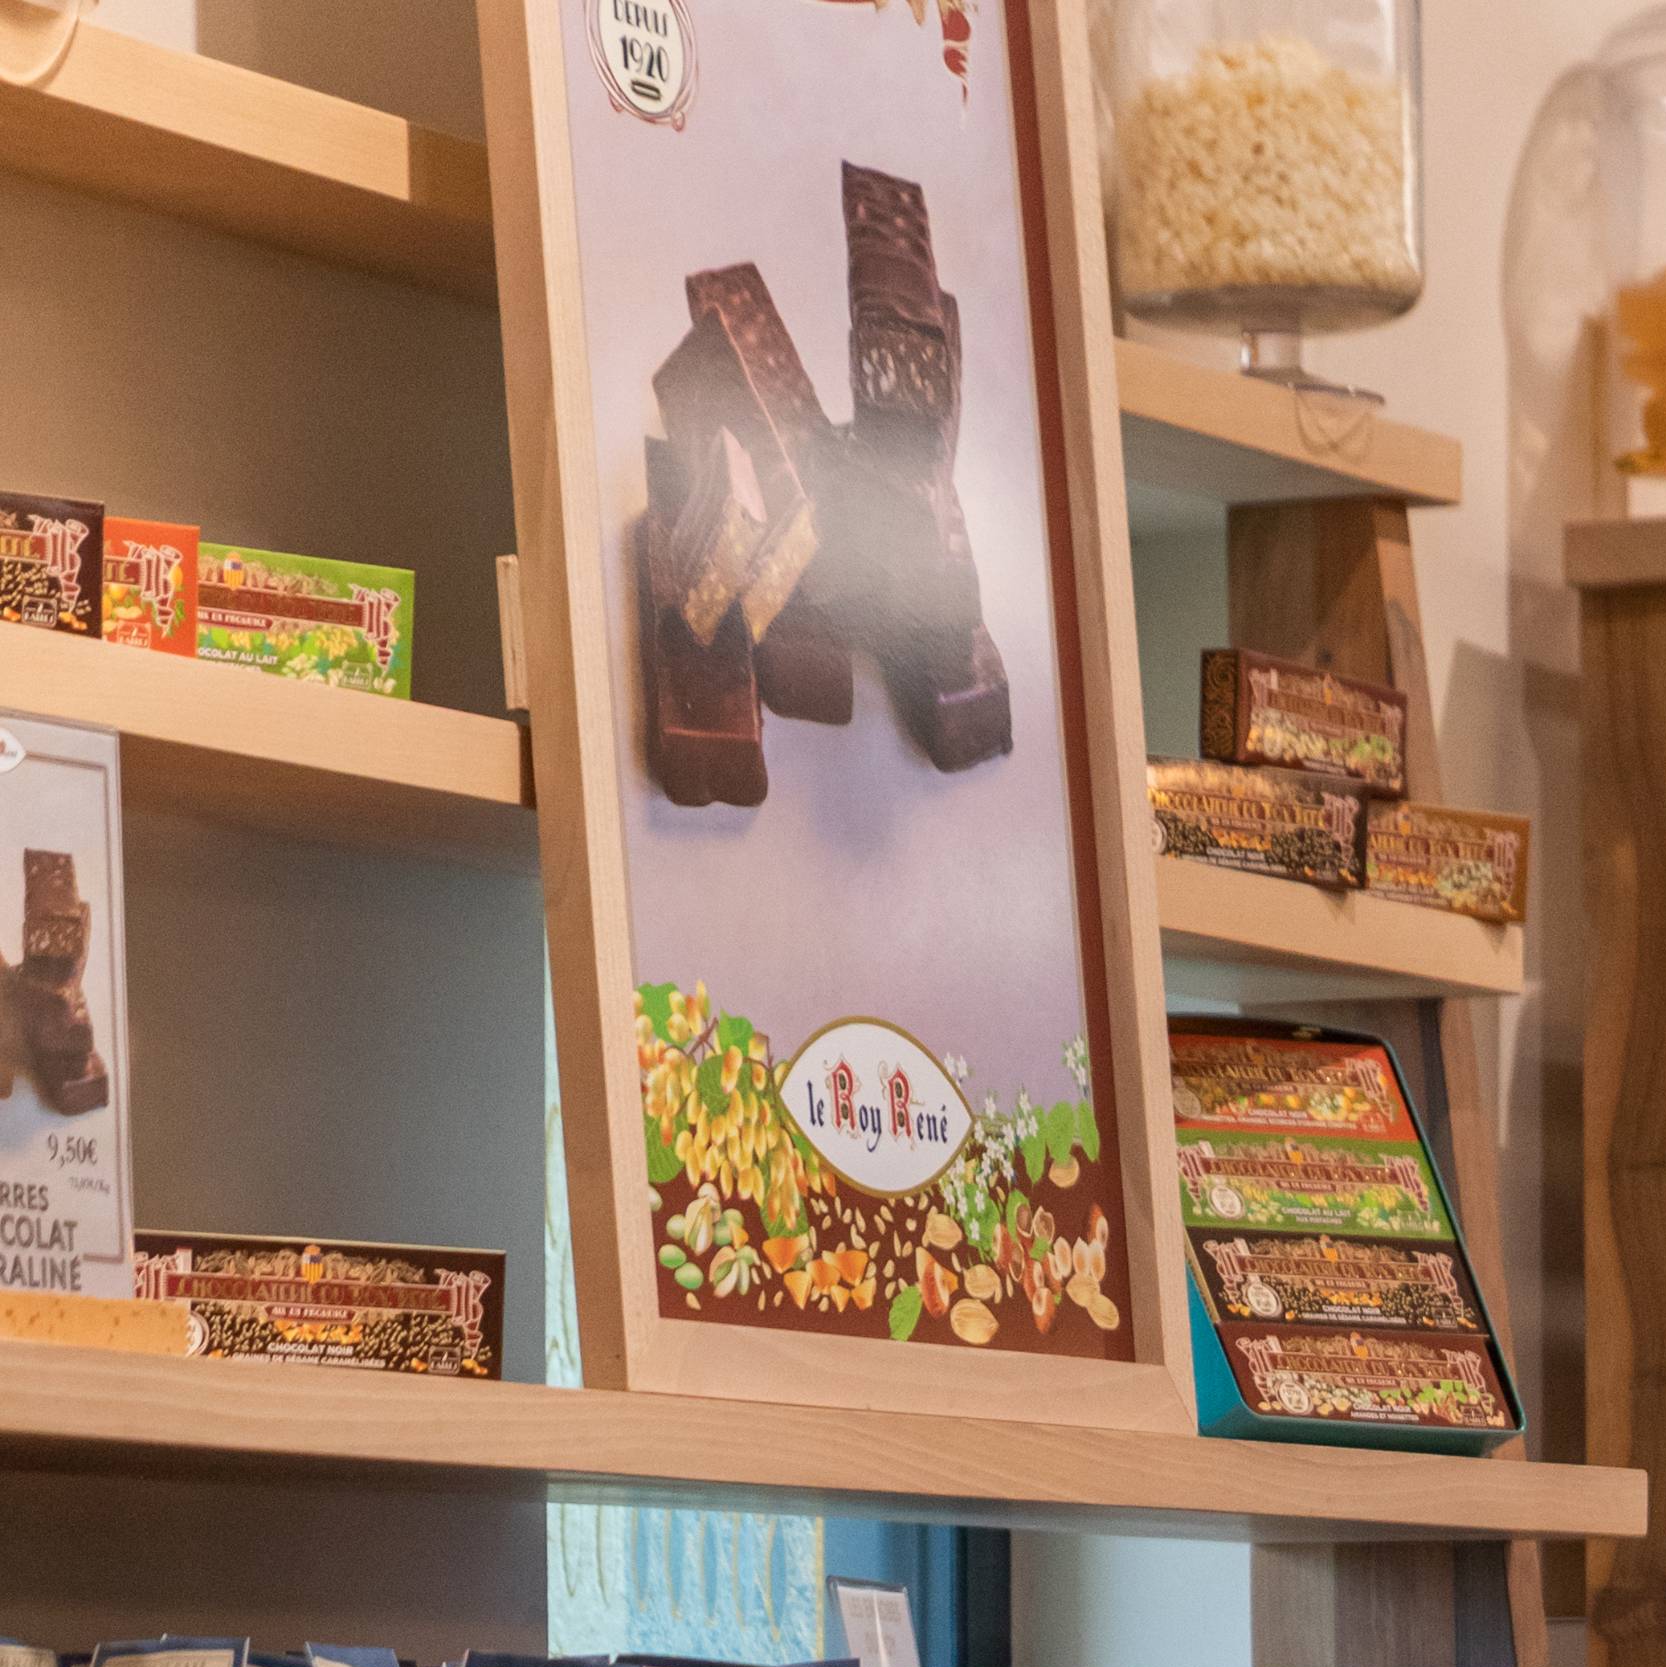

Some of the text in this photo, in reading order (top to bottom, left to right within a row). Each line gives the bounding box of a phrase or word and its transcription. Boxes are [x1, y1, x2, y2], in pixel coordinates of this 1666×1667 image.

[619, 35, 670, 82] 1920
[255, 653, 279, 665] LAIT
[806, 1056, 949, 1153] le Roy René
[47, 1132, 99, 1168] 9,50€
[0, 1181, 49, 1212] RRES
[0, 1219, 78, 1253] COLAT
[0, 1255, 82, 1292] RALINÉ
[1322, 1304, 1382, 1316] CHOCOLAT NOIR
[267, 1341, 355, 1356] CHOCOLAT NOIR
